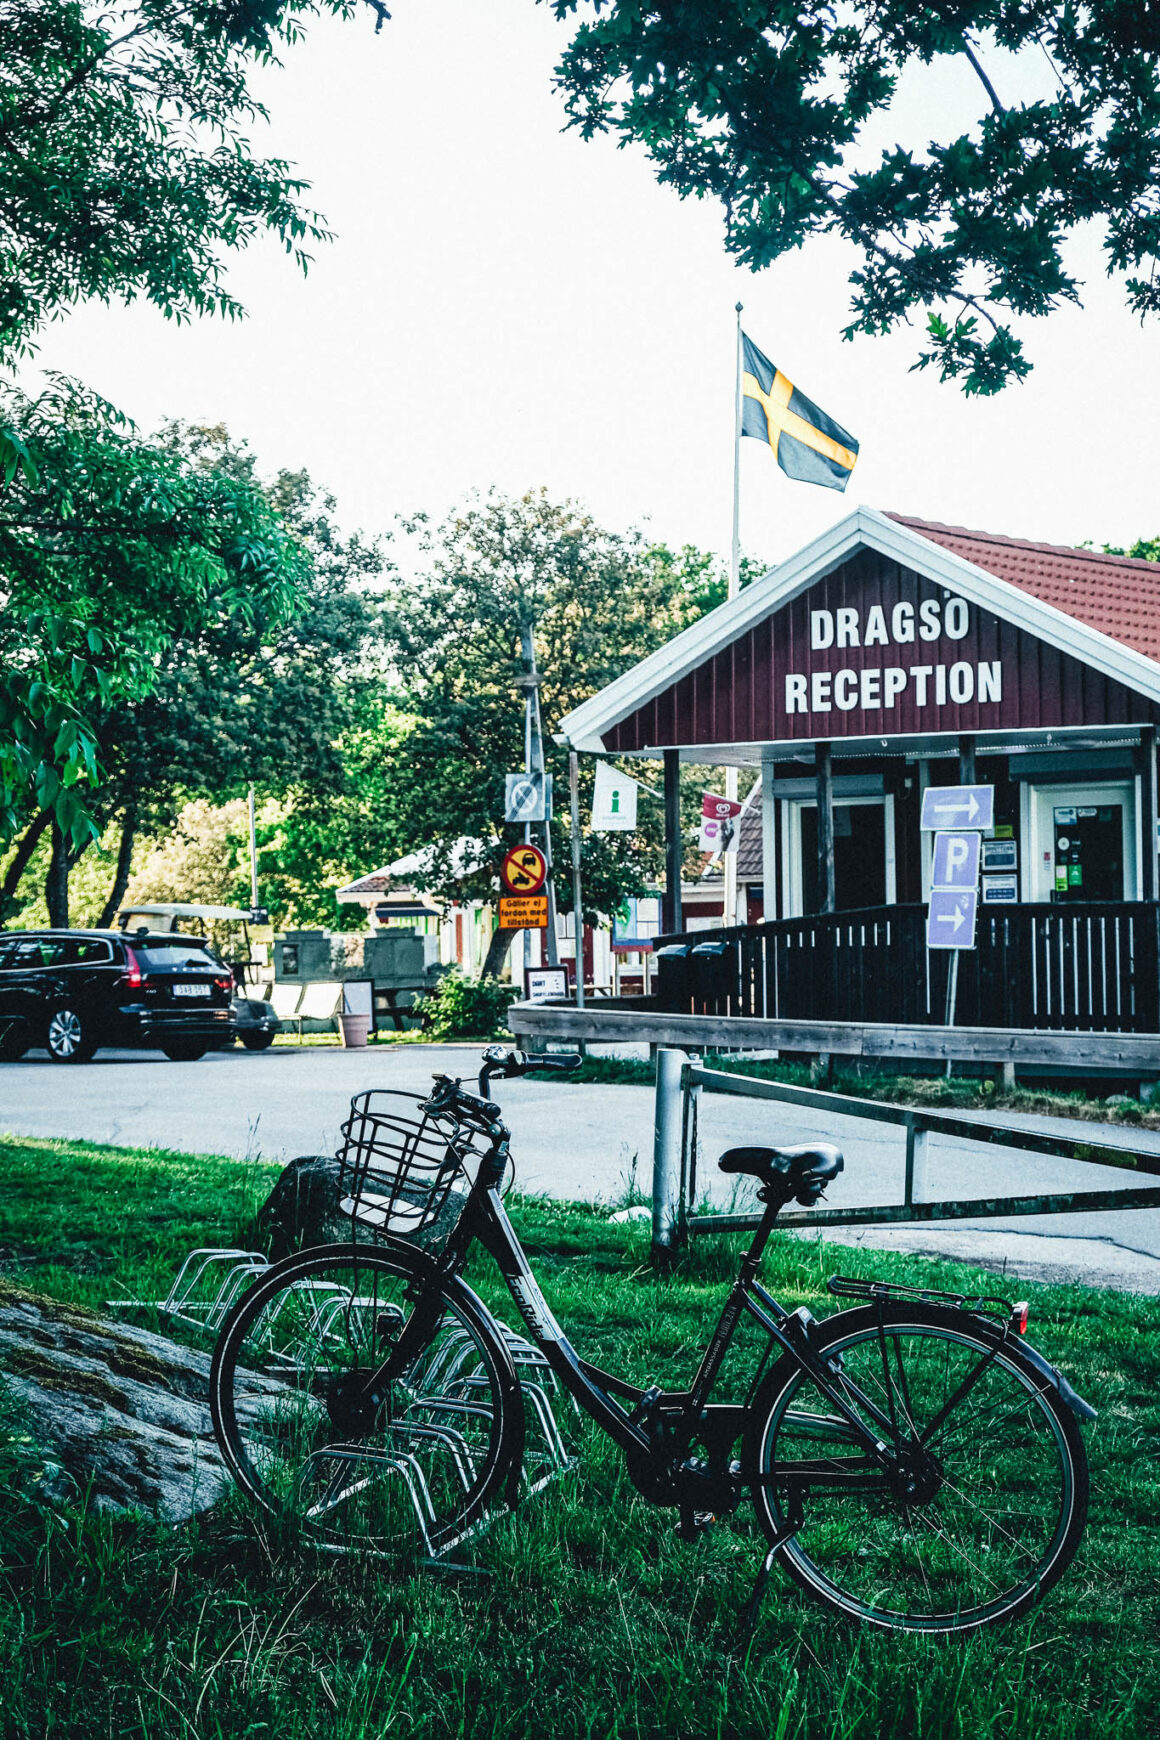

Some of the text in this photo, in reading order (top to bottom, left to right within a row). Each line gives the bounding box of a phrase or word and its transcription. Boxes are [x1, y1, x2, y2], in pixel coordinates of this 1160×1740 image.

[811, 590, 969, 650] DRAGSÖ
[785, 660, 1003, 714] RECEPTION
[945, 838, 969, 883] P
[501, 908, 547, 917] fordon med
[505, 1273, 546, 1341] EcoRide
